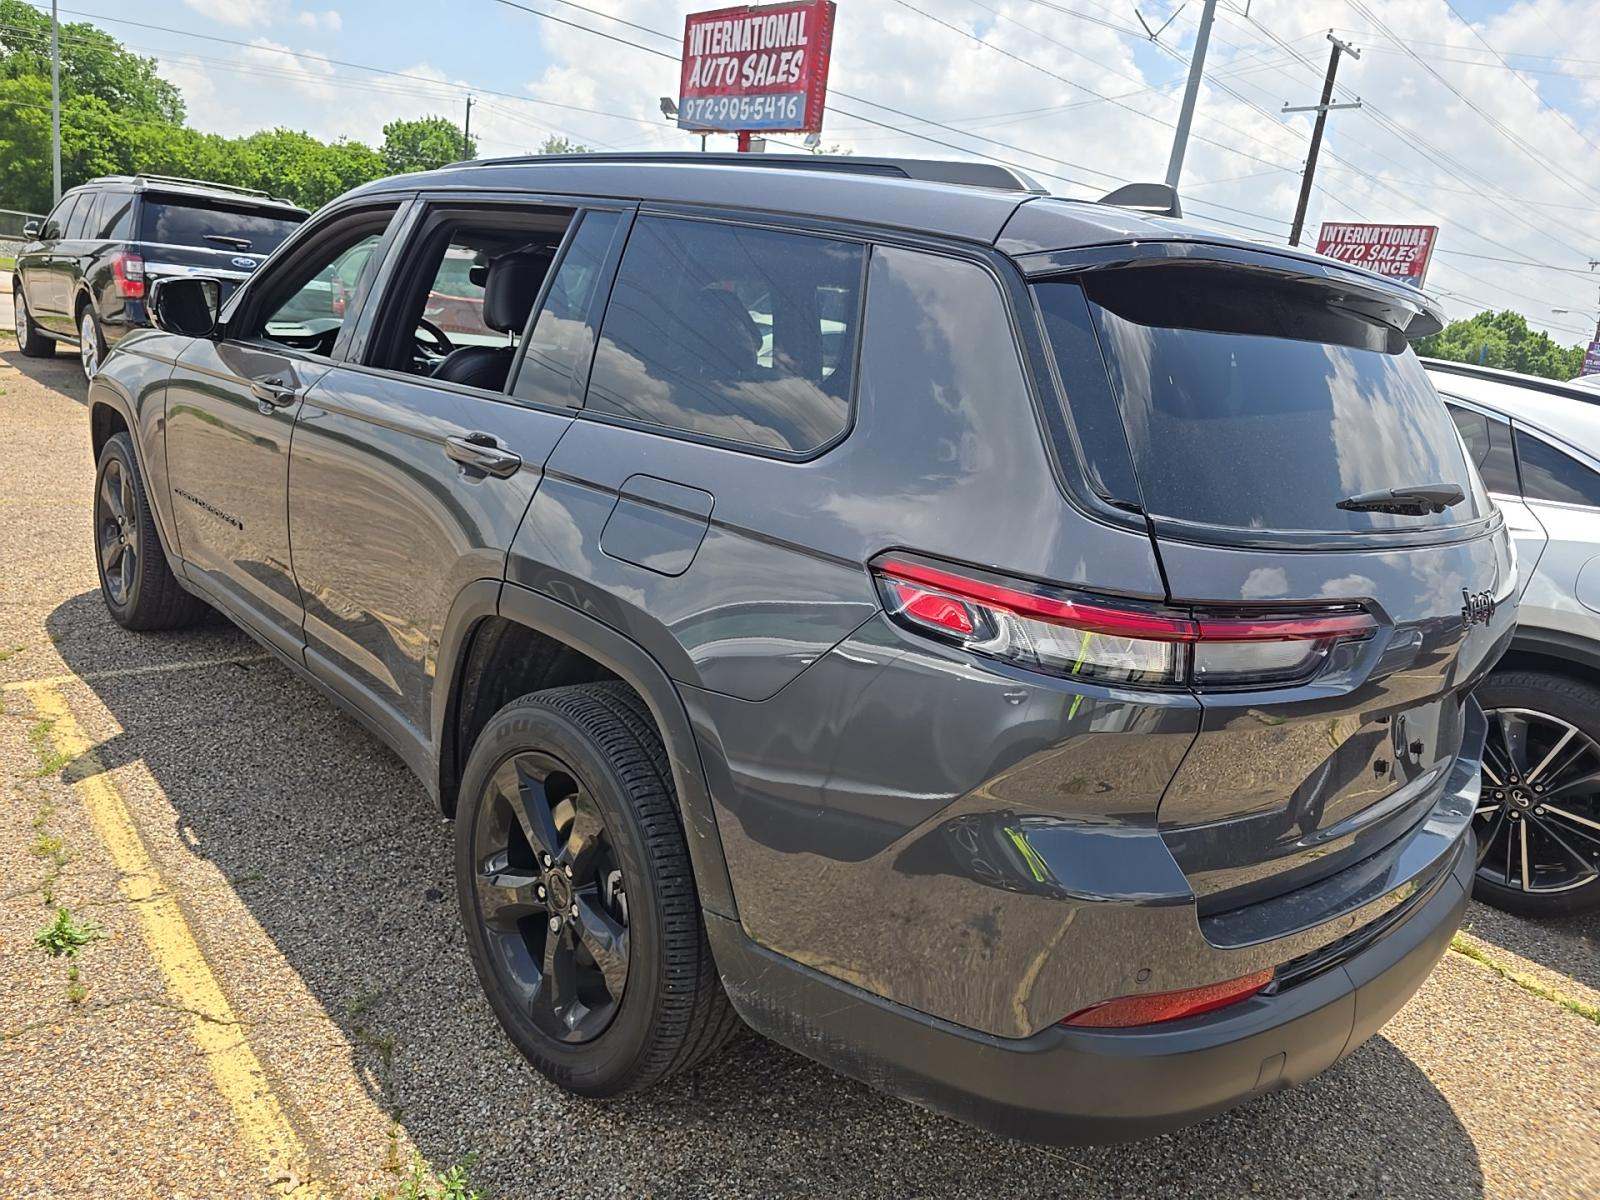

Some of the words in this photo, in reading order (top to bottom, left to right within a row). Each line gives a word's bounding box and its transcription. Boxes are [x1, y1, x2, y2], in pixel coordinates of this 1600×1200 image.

[689, 11, 808, 56] INTERNATIONAL
[690, 56, 739, 88] AUTO
[741, 50, 805, 88] SALES
[1322, 225, 1427, 246] INTERNATIONAL
[1323, 243, 1366, 259] AUTO
[1367, 244, 1419, 261] SALES
